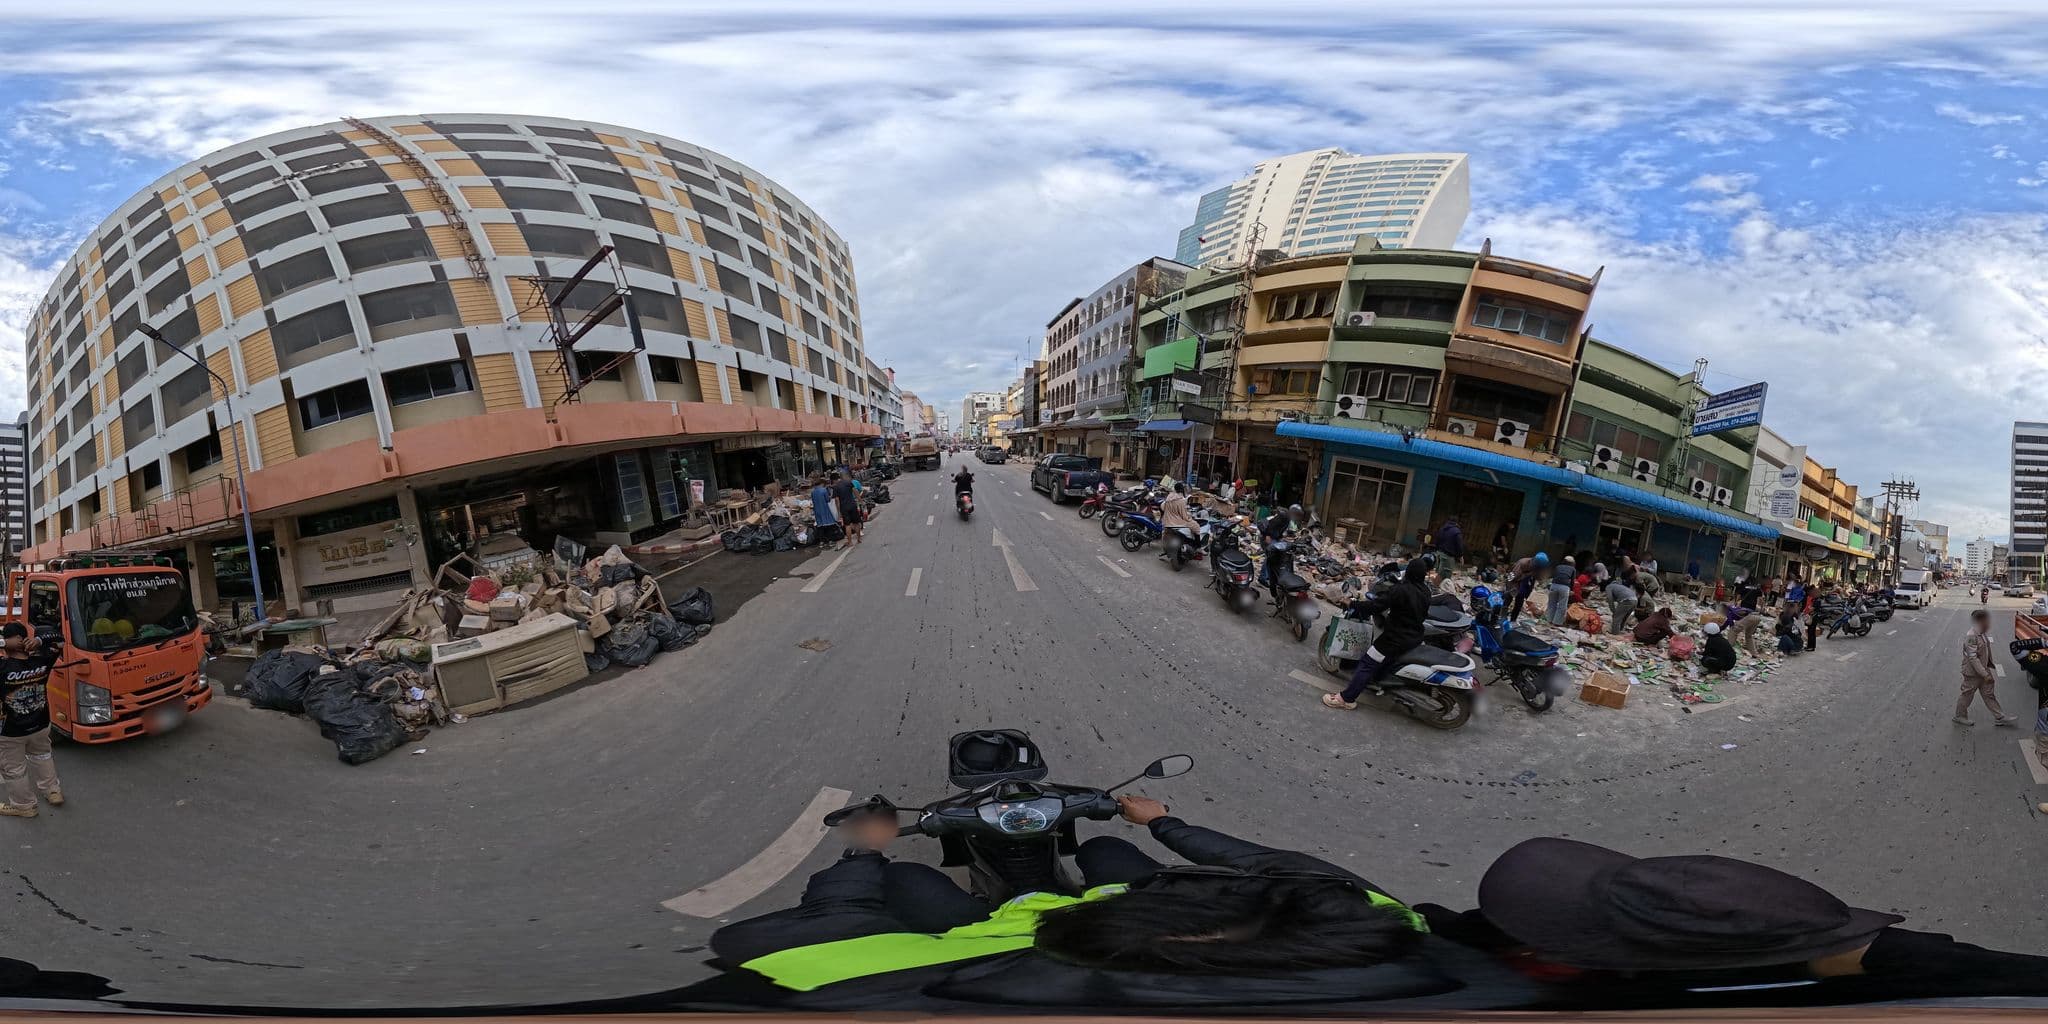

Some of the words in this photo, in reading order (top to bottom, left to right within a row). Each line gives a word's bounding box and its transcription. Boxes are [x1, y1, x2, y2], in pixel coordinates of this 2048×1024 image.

[87, 575, 177, 593] การไฟฟ้าส่วนภูมิภาค
[143, 670, 176, 684] ISUZU
